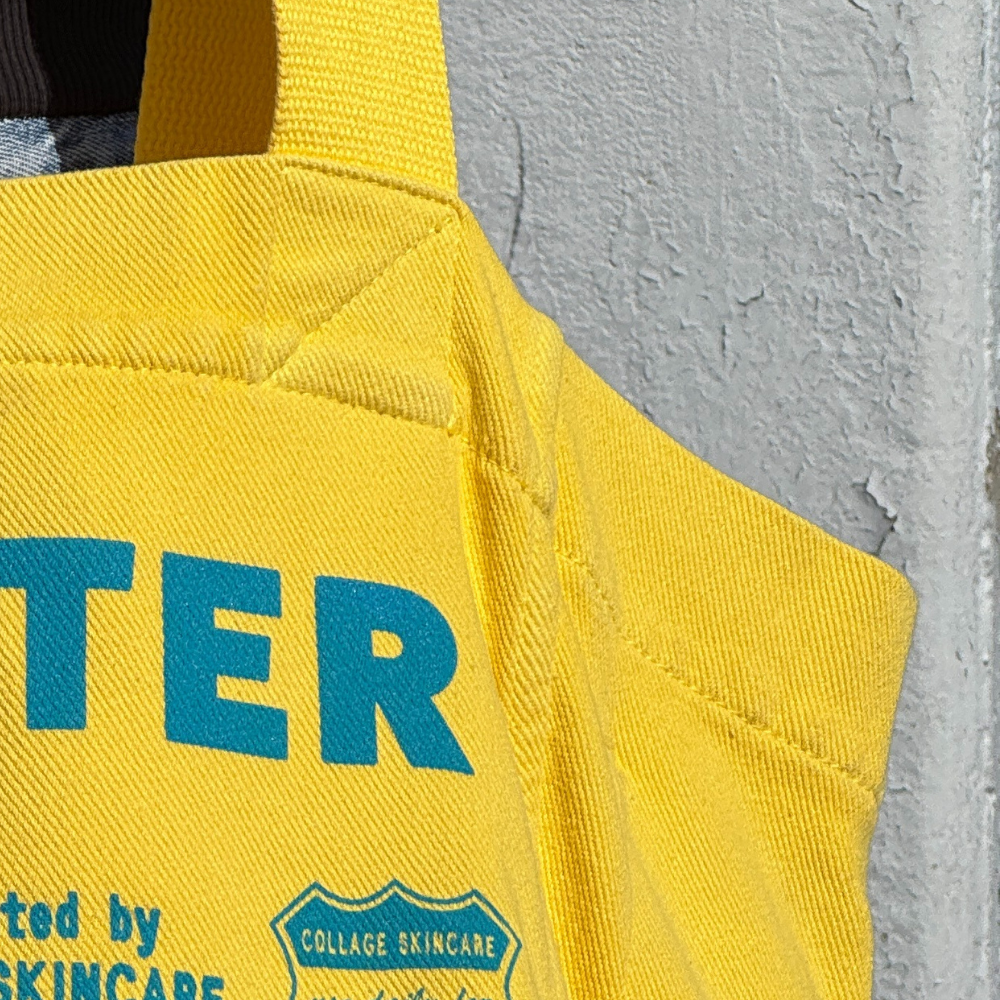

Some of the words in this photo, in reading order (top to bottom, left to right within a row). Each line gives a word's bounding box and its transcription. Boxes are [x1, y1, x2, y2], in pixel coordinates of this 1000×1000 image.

[110, 894, 161, 959] by
[301, 928, 387, 955] COLLAGE
[398, 930, 496, 958] SKINCARE
